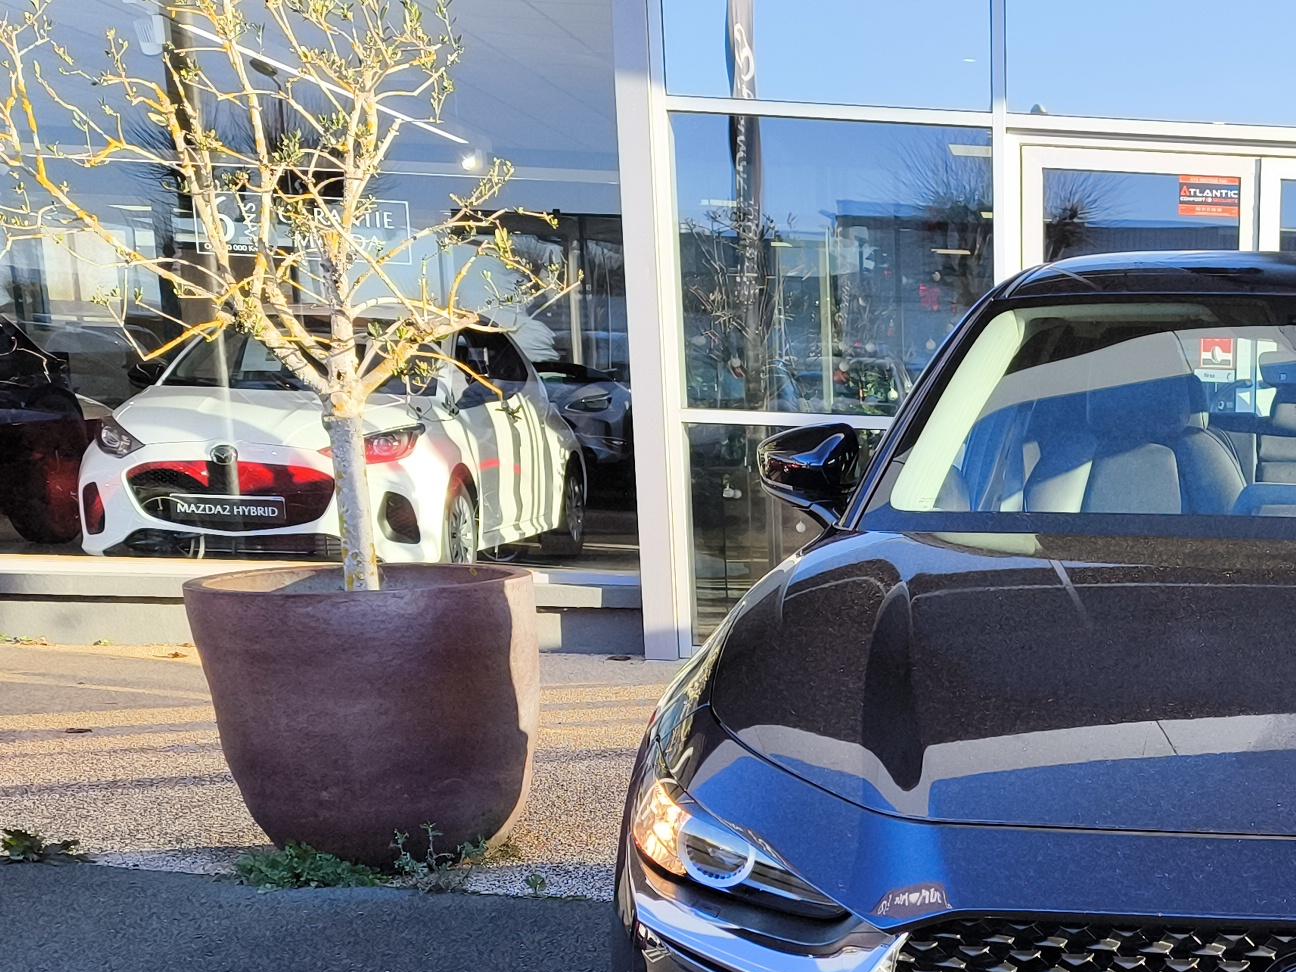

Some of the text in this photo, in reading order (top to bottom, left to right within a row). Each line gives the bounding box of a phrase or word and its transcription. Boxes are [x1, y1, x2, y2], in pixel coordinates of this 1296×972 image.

[1180, 185, 1239, 198] ATLANTIC
[177, 503, 278, 517] MAZDA2 HYBRID
